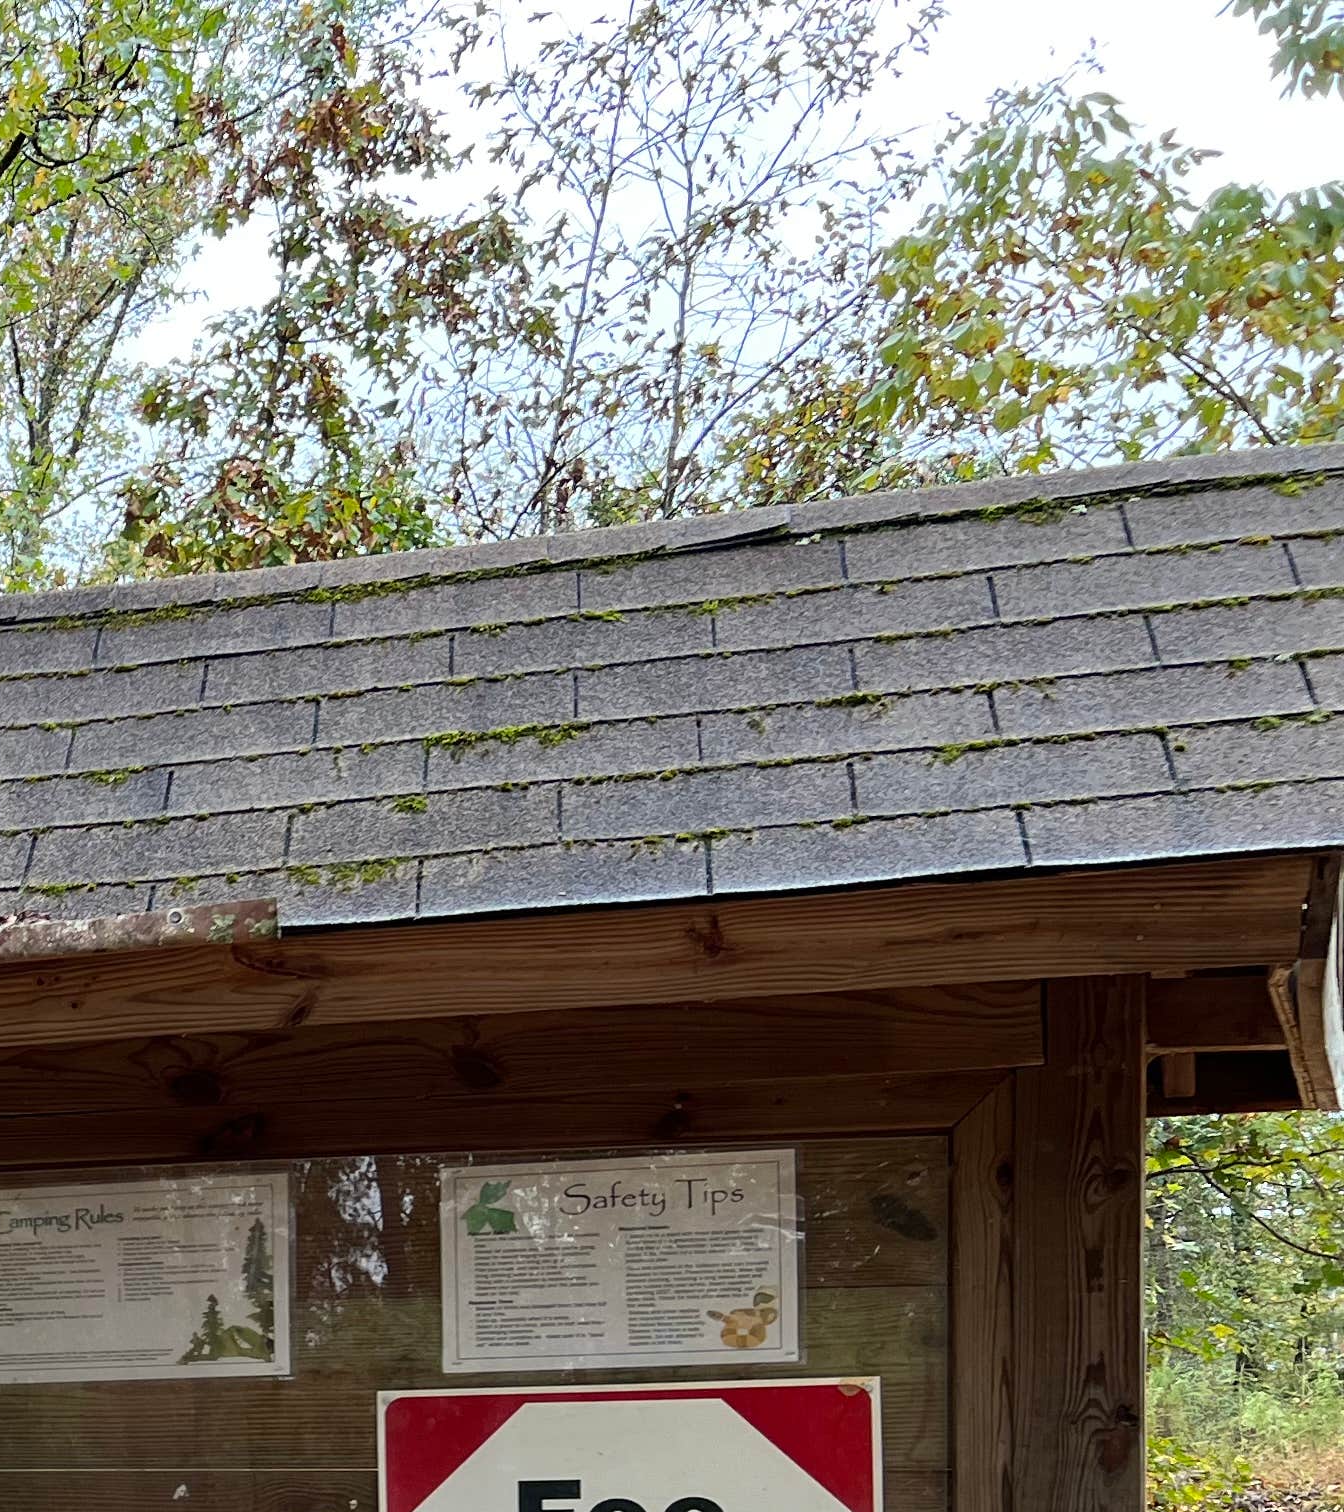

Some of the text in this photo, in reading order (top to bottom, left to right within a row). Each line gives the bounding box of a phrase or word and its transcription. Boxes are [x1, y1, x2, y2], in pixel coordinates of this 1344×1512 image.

[559, 1178, 745, 1217] Safety Tips
[75, 1204, 125, 1231] Rules
